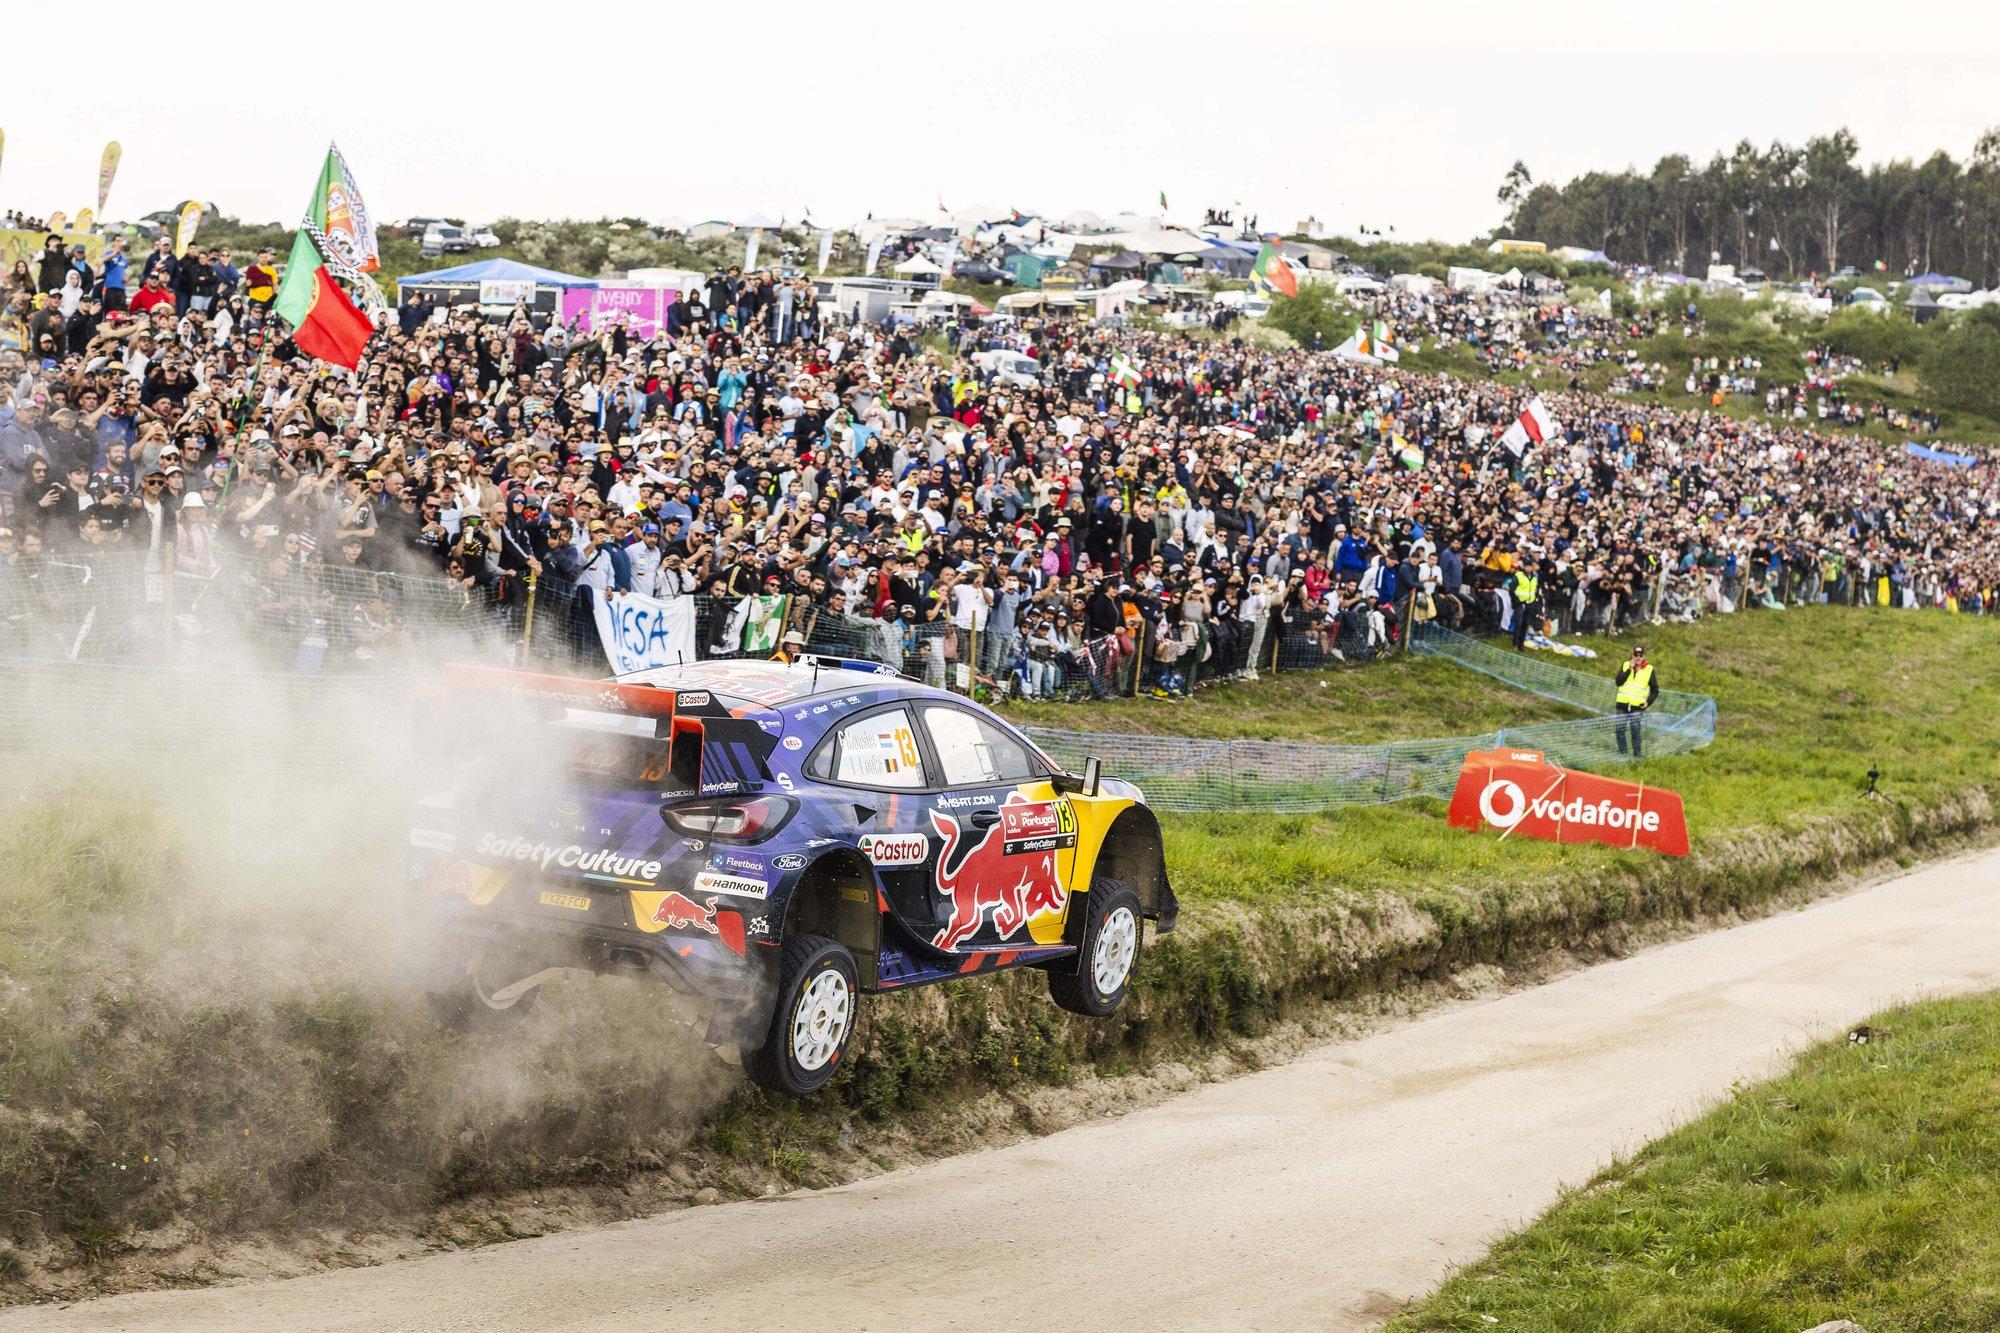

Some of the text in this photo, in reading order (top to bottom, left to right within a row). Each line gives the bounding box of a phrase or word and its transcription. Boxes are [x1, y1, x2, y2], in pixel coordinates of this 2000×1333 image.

[684, 692, 709, 704] Castrol
[895, 728, 917, 767] 13
[1511, 751, 1538, 763] WRC
[702, 782, 738, 792] SafetyCulture
[661, 790, 695, 798] sparco
[1022, 814, 1056, 826] Portugal
[1055, 801, 1074, 833] 13
[1532, 797, 1660, 832] vodafone
[874, 839, 924, 860] Castrol
[1023, 839, 1056, 850] SafetyCulture
[476, 832, 662, 879] SafetyCulture
[726, 857, 764, 872] Fleetback
[778, 856, 802, 868] Ford
